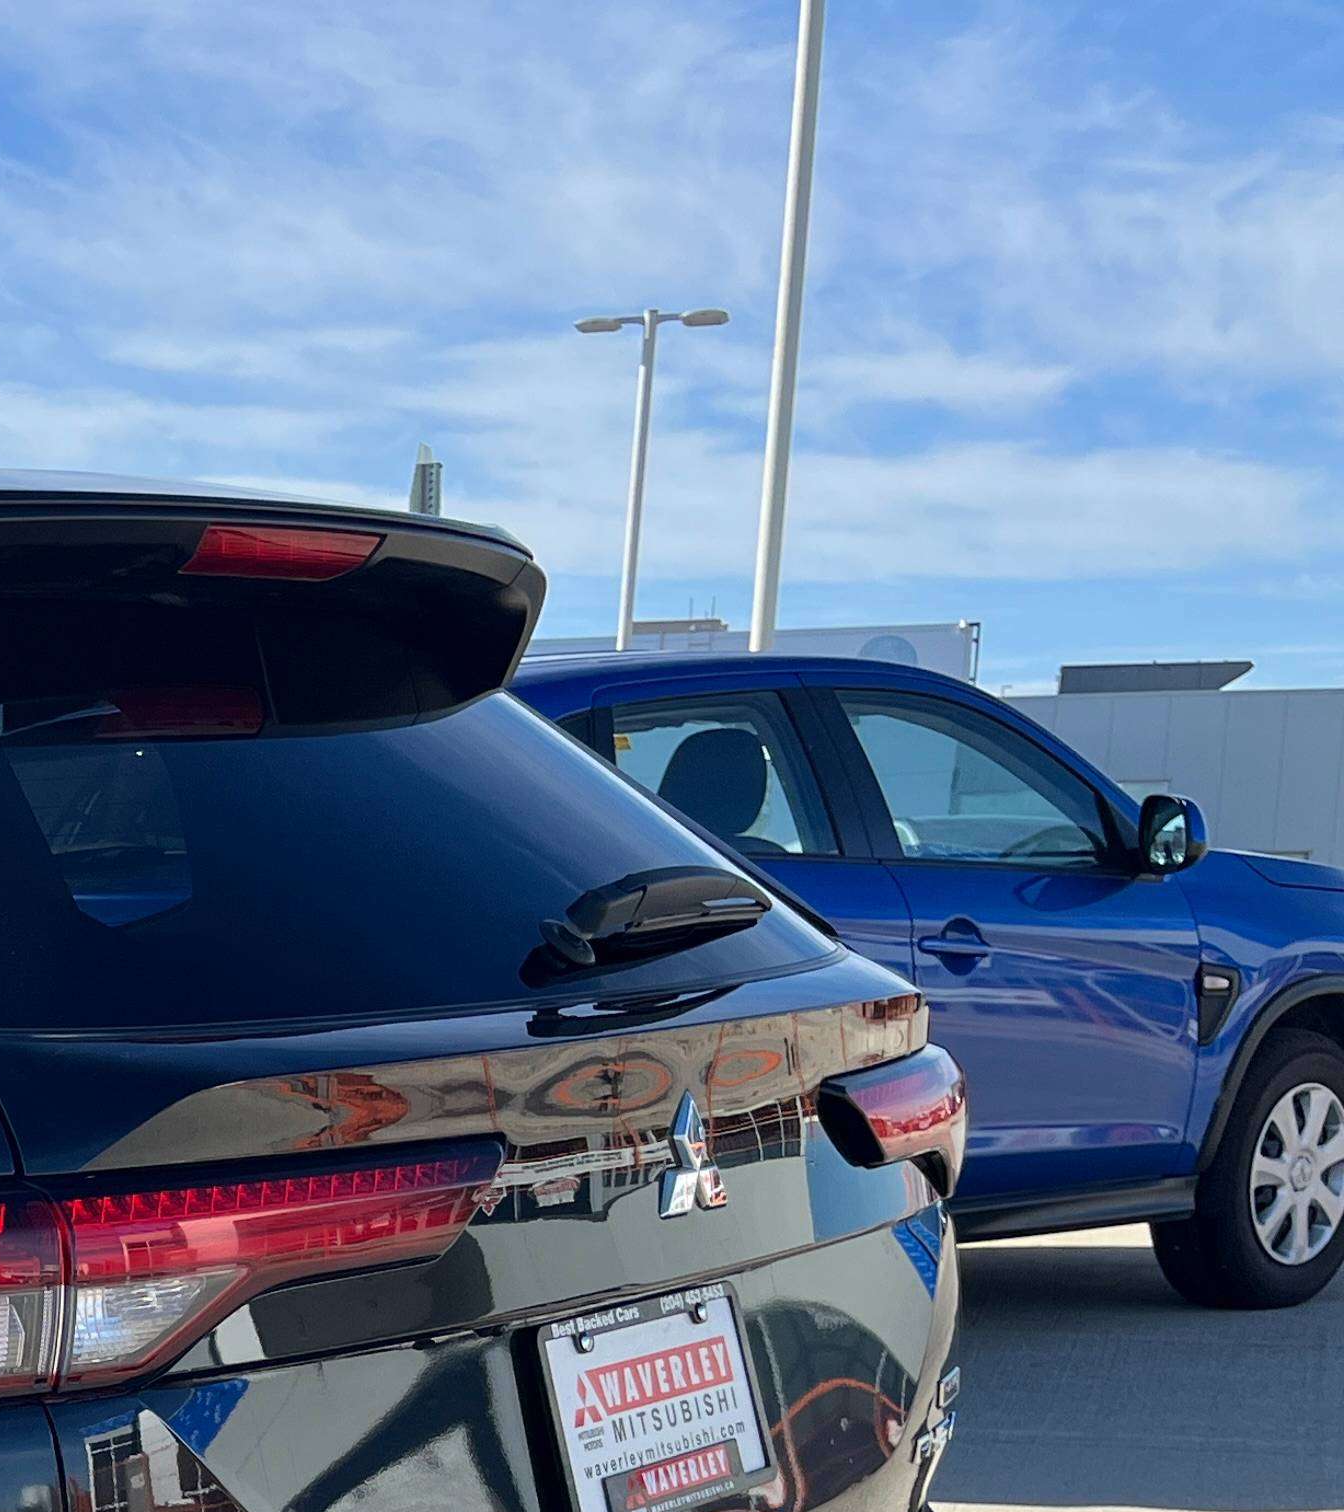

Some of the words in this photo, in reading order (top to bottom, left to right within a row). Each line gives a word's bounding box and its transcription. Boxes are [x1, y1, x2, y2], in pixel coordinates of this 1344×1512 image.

[551, 1320, 576, 1338] Best
[577, 1312, 615, 1331] Backed
[616, 1307, 640, 1322] Cars
[598, 1342, 727, 1408] WAVERLEY
[612, 1387, 738, 1443] MITSUBISHI
[584, 1420, 745, 1480] waverleymitsubishi.com
[642, 1449, 726, 1496] WAVERLEY
